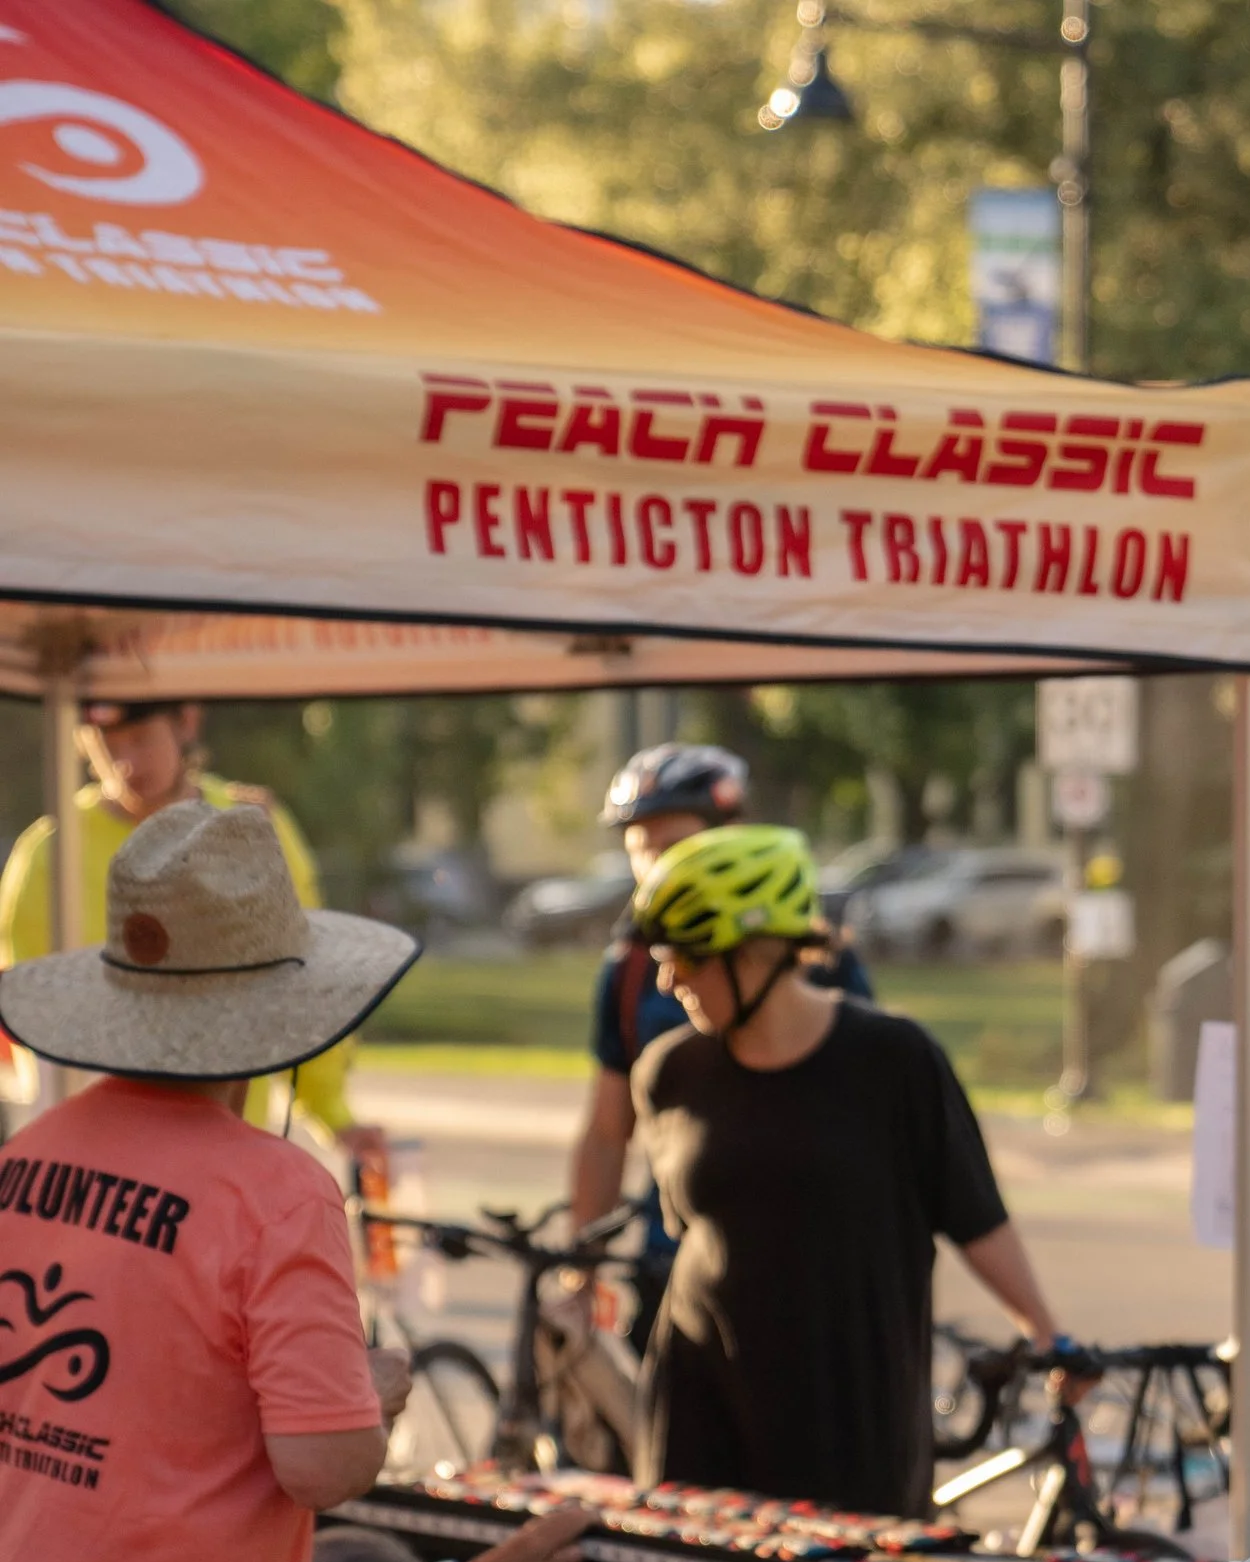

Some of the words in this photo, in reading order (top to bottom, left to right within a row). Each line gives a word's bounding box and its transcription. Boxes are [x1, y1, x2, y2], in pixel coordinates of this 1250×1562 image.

[418, 372, 767, 468] PEACH
[803, 400, 1205, 500] CLASSIC
[425, 478, 812, 579] PENTICTON
[840, 509, 1191, 603] TRIATHLON
